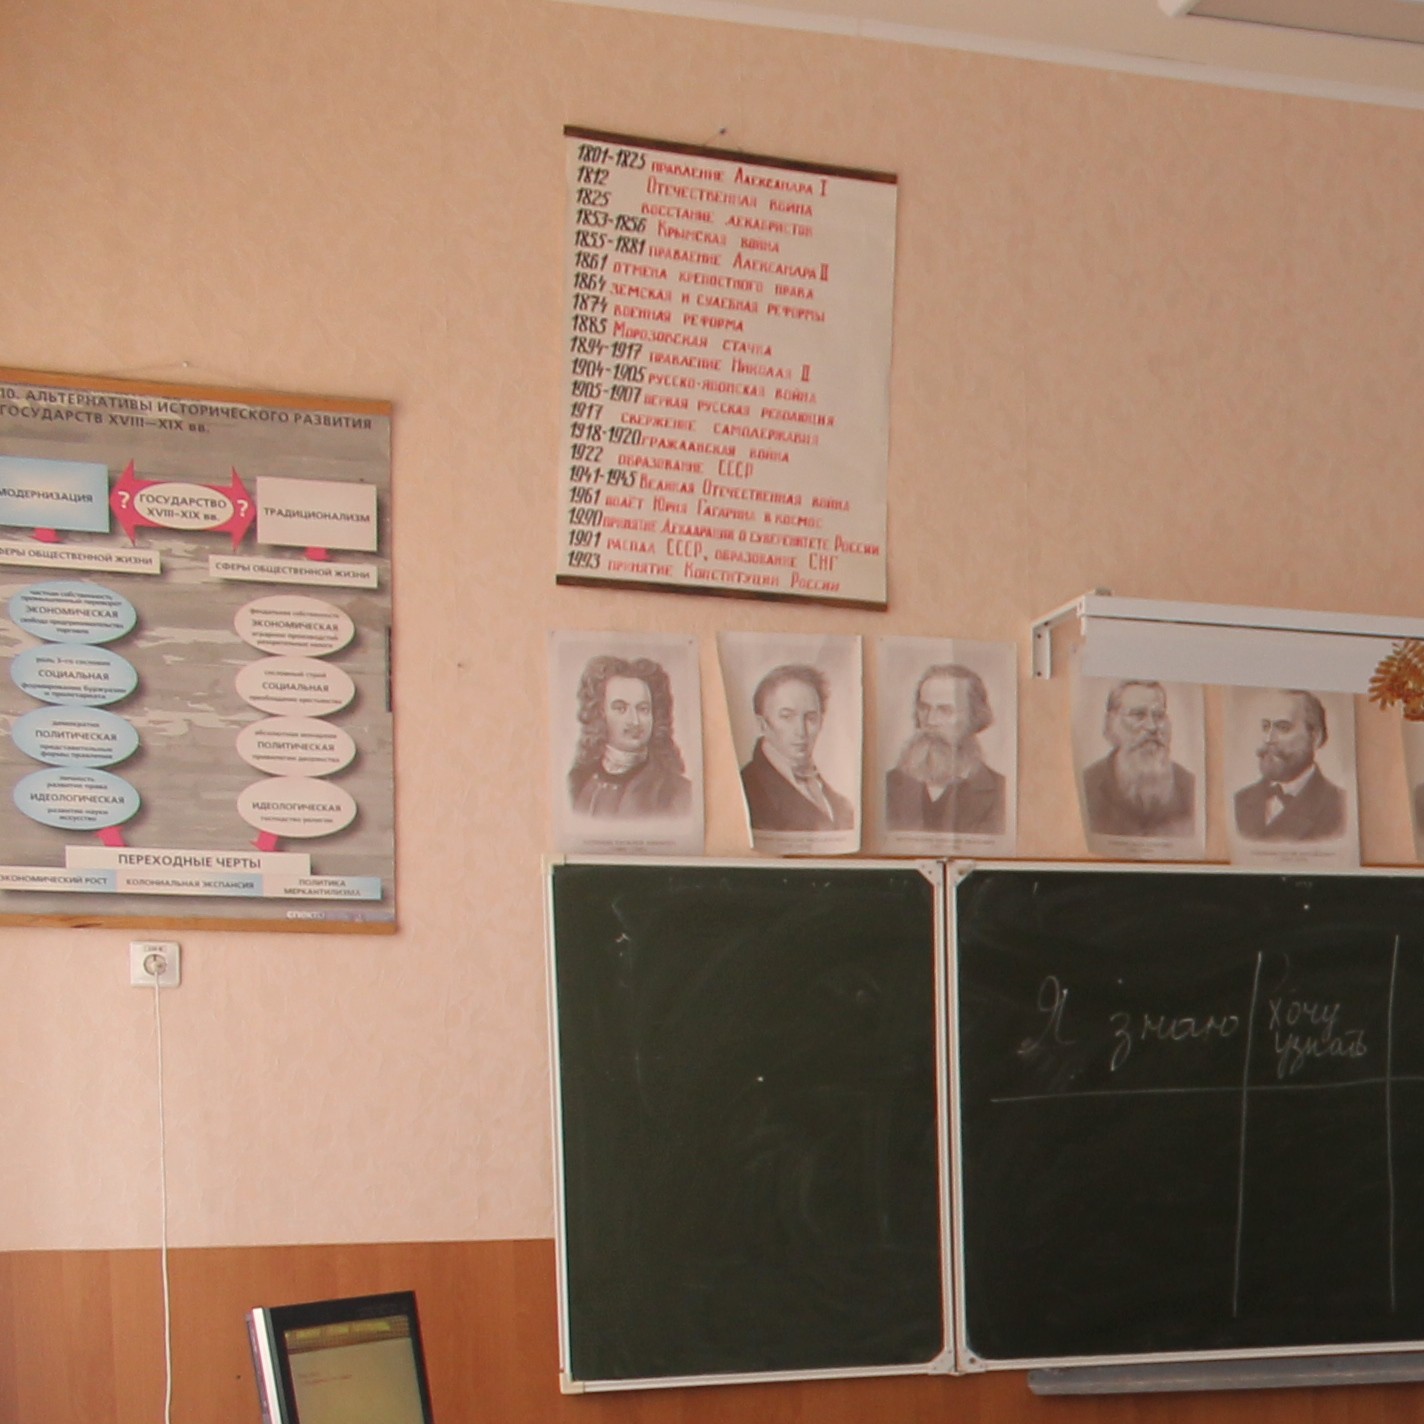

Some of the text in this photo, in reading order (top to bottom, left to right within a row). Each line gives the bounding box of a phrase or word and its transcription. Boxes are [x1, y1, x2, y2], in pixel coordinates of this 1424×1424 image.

[577, 144, 646, 170] 1801-1825
[576, 167, 609, 186] 1812
[576, 188, 612, 207] 1825
[575, 209, 646, 233] 1853-1856
[574, 229, 645, 254] 1855-1881
[574, 251, 608, 271] 1861
[573, 272, 606, 293] 1864
[572, 293, 607, 314] 1874
[571, 314, 606, 335] 1885
[570, 335, 642, 362] 1894-1917
[571, 358, 647, 383] 1904-1905
[571, 380, 642, 404] 1905-1907
[26, 388, 152, 412] АЛЬТЕРНАТИВЫ
[157, 401, 289, 425] ИСТОРИЧЕСКОГО
[294, 413, 373, 431] РАЗВИТИЯ
[570, 402, 604, 420] 1917
[570, 423, 641, 446] 1918-1920
[570, 444, 603, 462] 1922
[718, 459, 753, 479] СССР
[569, 465, 637, 489] 1941-1945
[139, 491, 227, 509] ГОСУДАРСТВО
[568, 485, 601, 506] 1961
[568, 507, 603, 526] 1990
[568, 530, 601, 549] 1991
[567, 551, 601, 570] 1993
[118, 853, 261, 869] ПЕРЕХОДНЫЕ ЧЕРТЫ
[1017, 975, 1240, 1071] Я знаю
